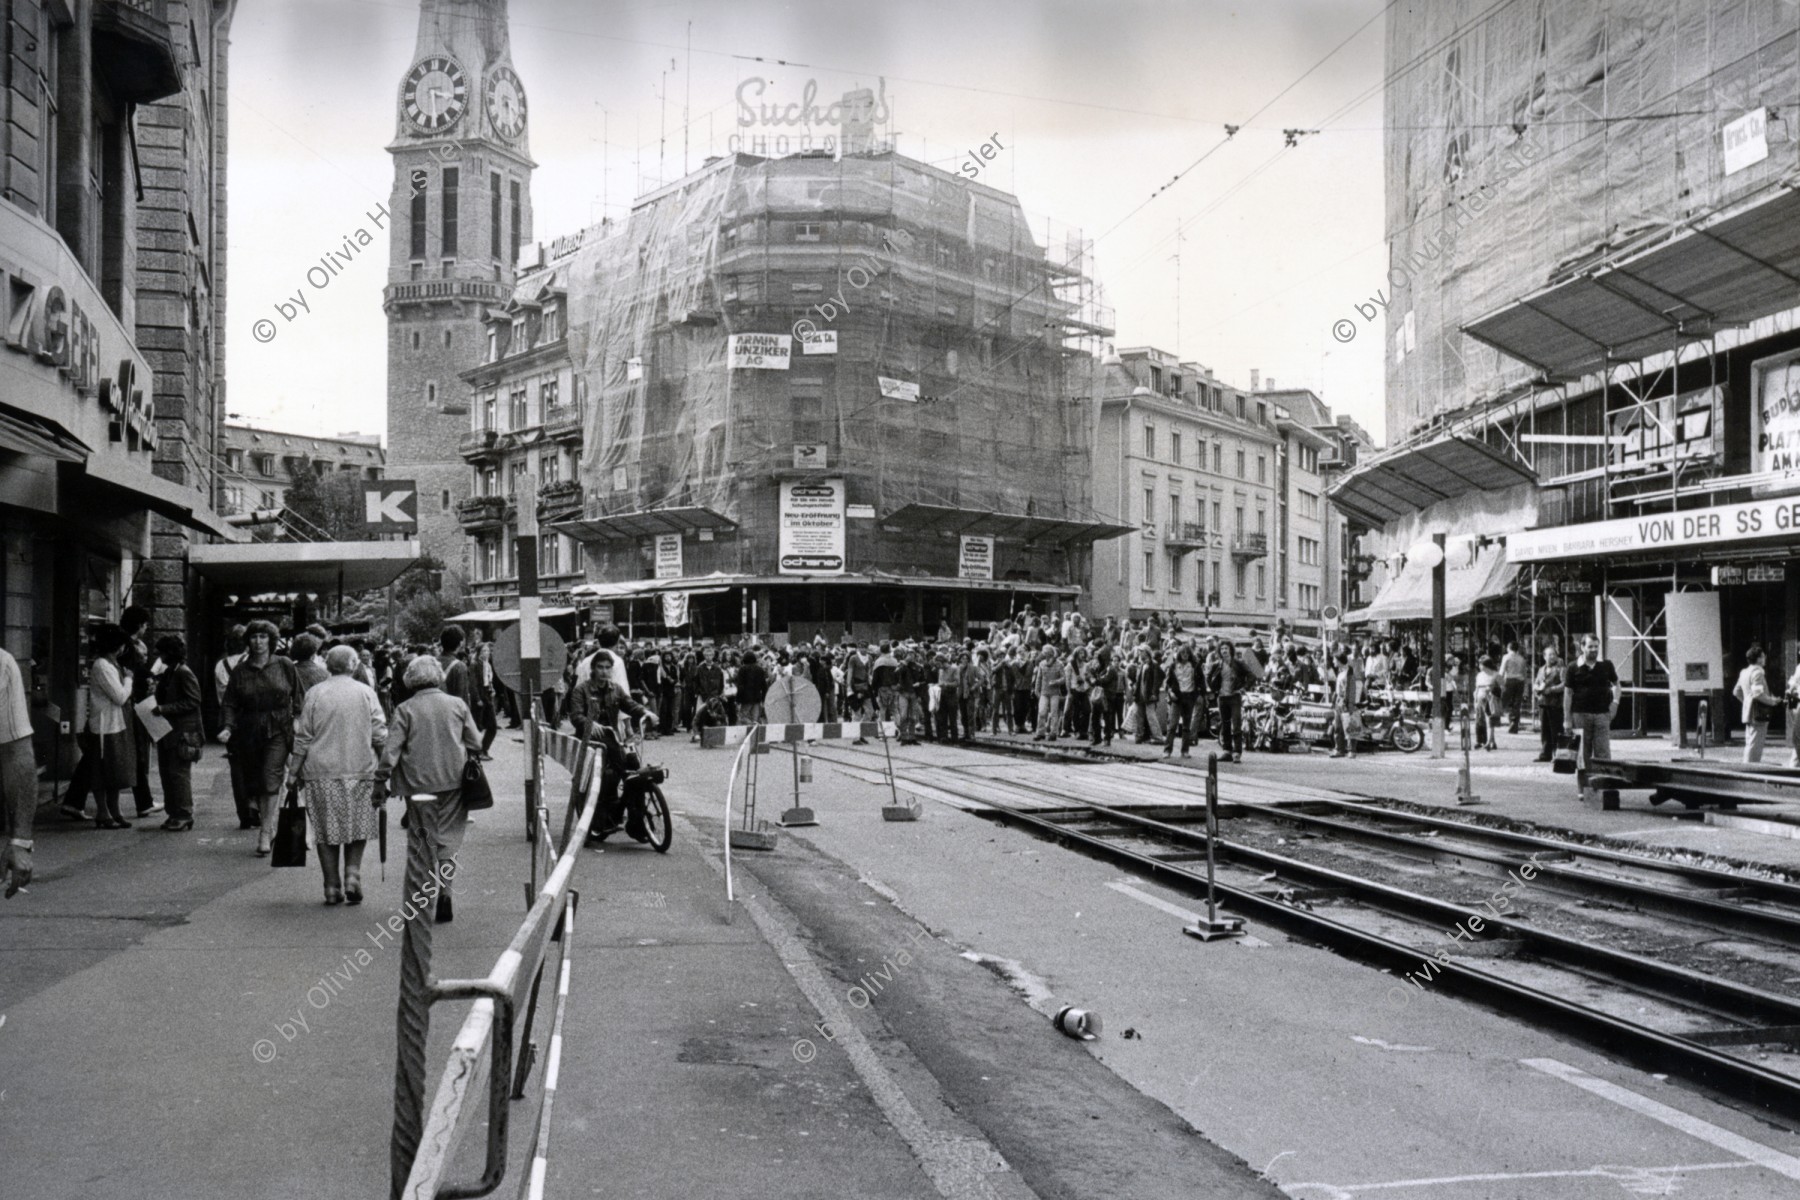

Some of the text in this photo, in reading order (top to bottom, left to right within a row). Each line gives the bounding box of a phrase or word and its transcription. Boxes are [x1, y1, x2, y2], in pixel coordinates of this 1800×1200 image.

[735, 76, 889, 128] Suchard
[735, 345, 789, 357] UNZIKER
[737, 335, 779, 346] ARMIN
[746, 355, 764, 366] AG
[1762, 396, 1787, 426] BUD
[365, 490, 416, 523] K
[1563, 537, 1595, 552] BARBARA
[1599, 535, 1633, 549] HERSHEY
[1638, 520, 1675, 544] VON
[1683, 513, 1721, 539] DER
[1736, 508, 1762, 533] SS
